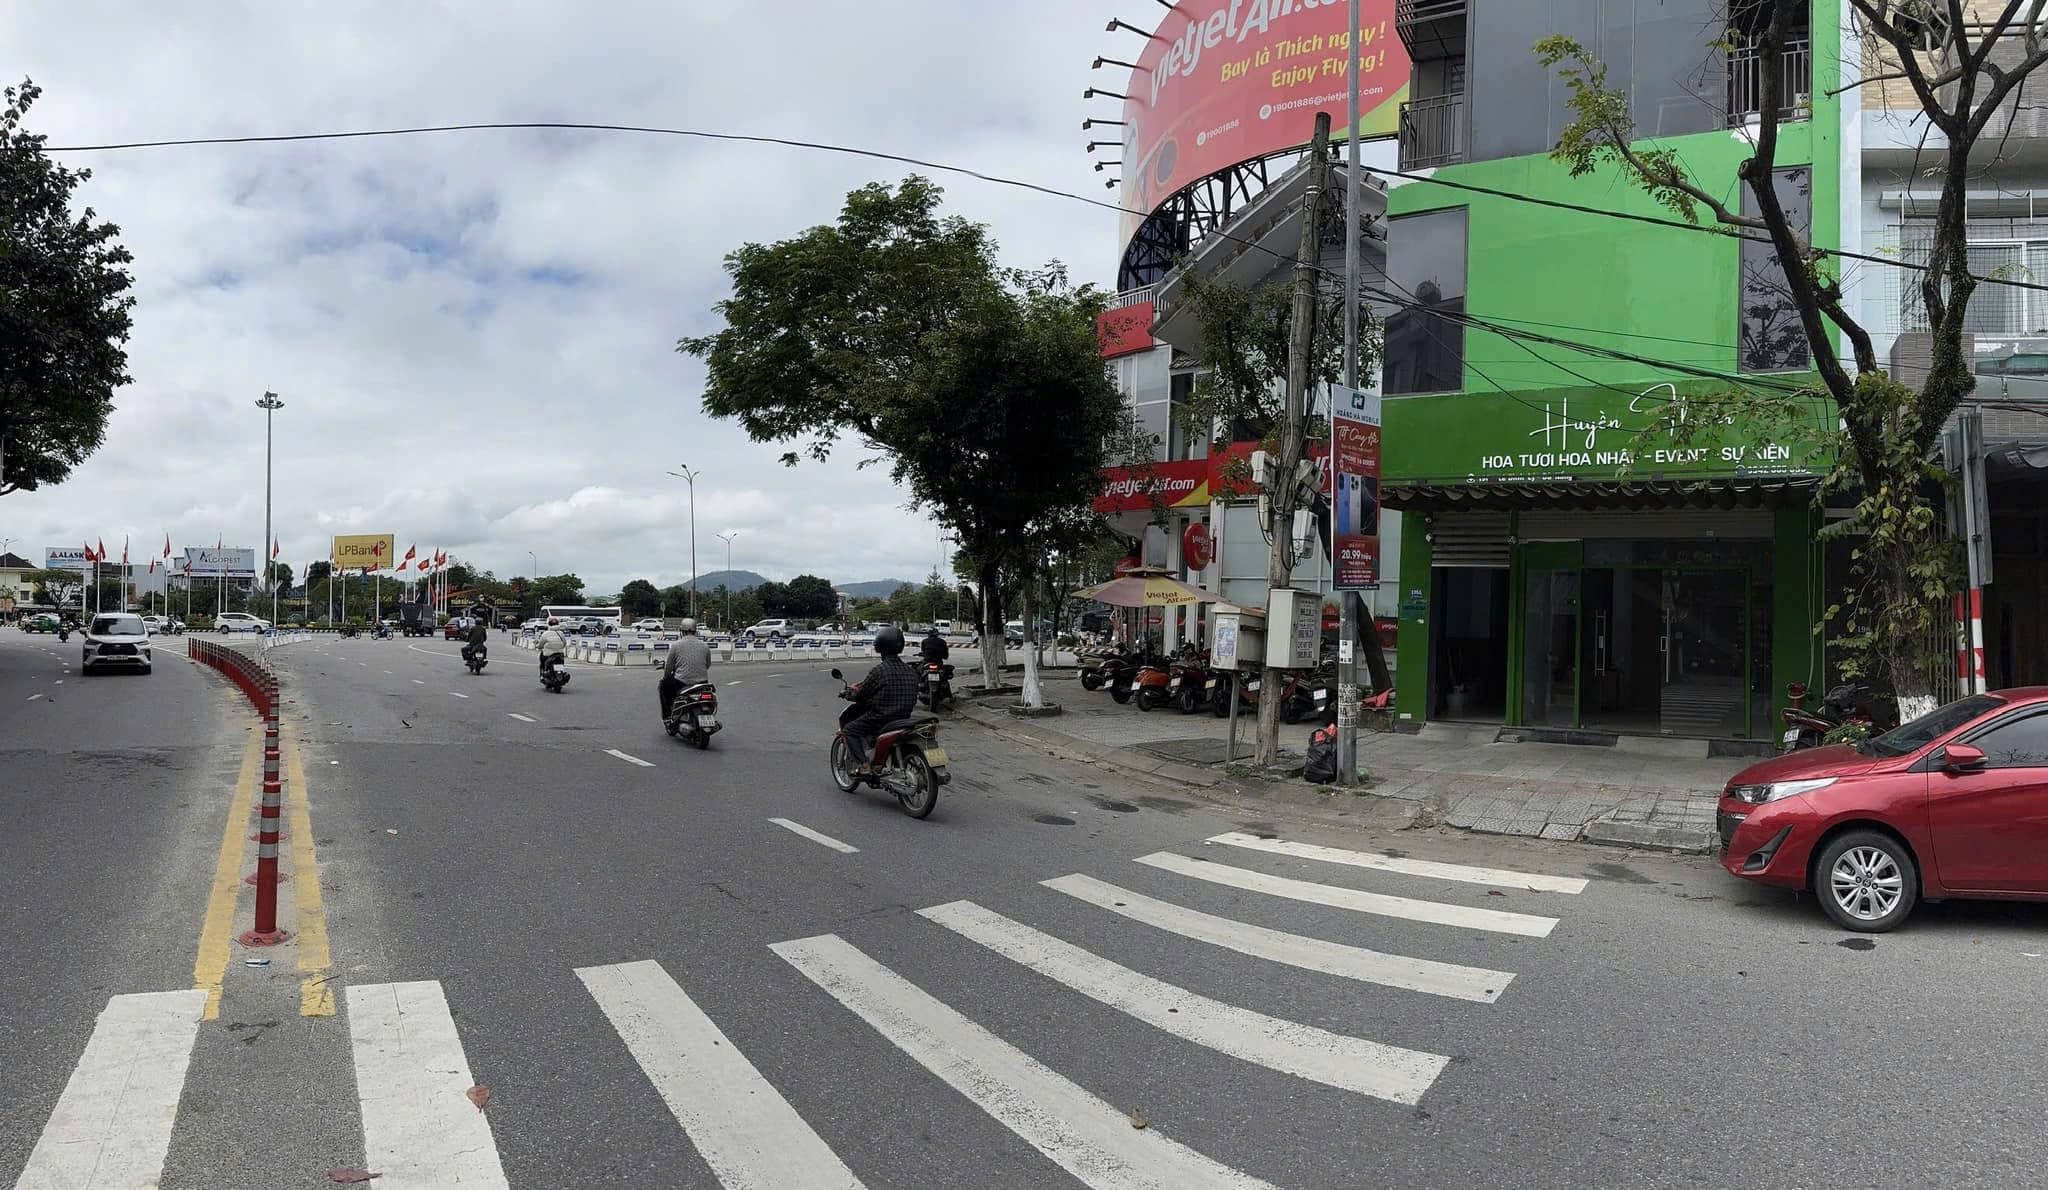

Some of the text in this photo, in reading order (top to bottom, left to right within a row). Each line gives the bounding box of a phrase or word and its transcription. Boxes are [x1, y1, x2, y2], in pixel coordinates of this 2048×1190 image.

[1221, 59, 1251, 82] Bay
[1255, 48, 1271, 67] là
[1328, 25, 1376, 49] ngy
[1271, 65, 1317, 88] Enjoy
[1322, 55, 1376, 79] Flyng
[1482, 455, 1514, 469] HOA
[1519, 452, 1555, 468] TƯƠI
[1558, 452, 1592, 467] HOA
[1721, 445, 1746, 464] SỰ
[58, 551, 86, 560] ALASK
[1341, 549, 1361, 560] 20.99
